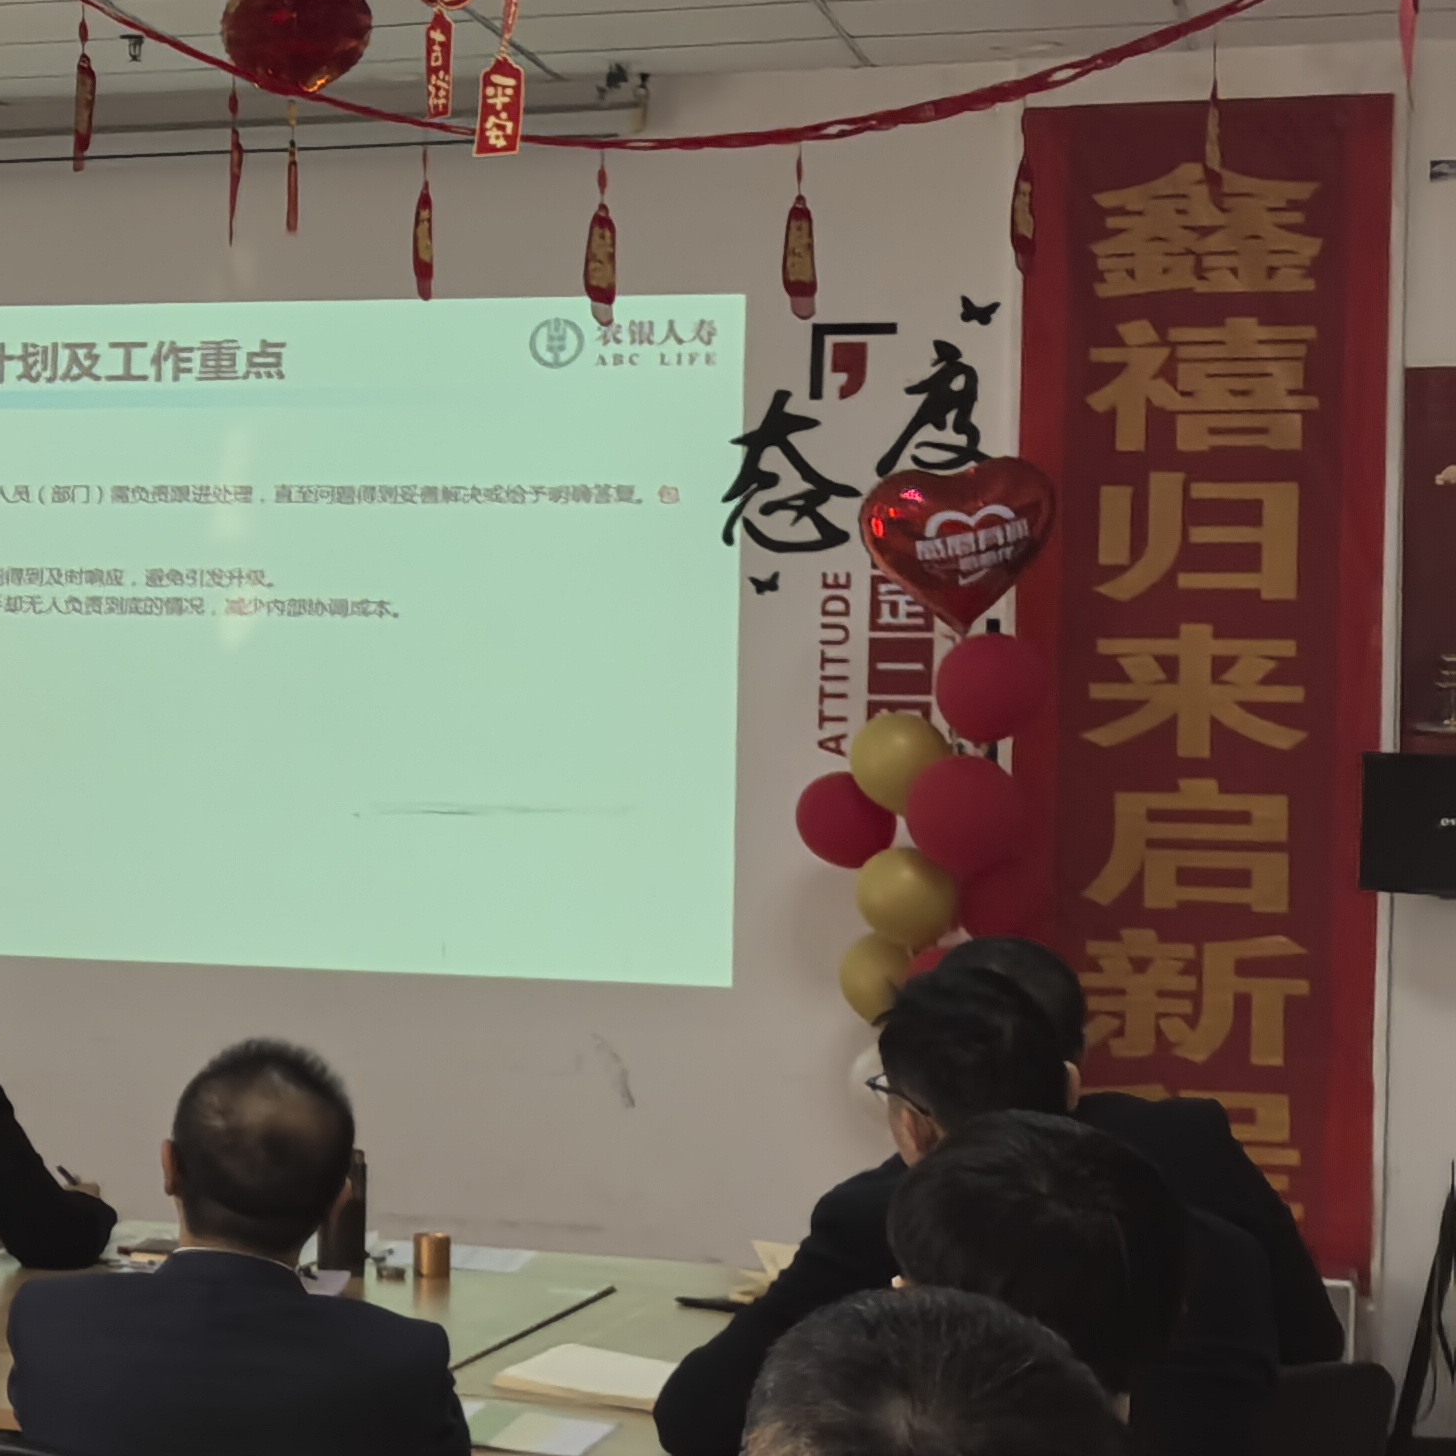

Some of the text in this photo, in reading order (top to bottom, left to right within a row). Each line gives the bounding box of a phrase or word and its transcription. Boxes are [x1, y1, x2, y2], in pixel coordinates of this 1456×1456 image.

[484, 73, 517, 149] 平安
[596, 319, 717, 347] 农银人寿
[596, 351, 717, 367] ABC LIFE
[818, 571, 851, 757] ATTITUDE
[1081, 162, 1323, 1228] 鑫禧归来启新
